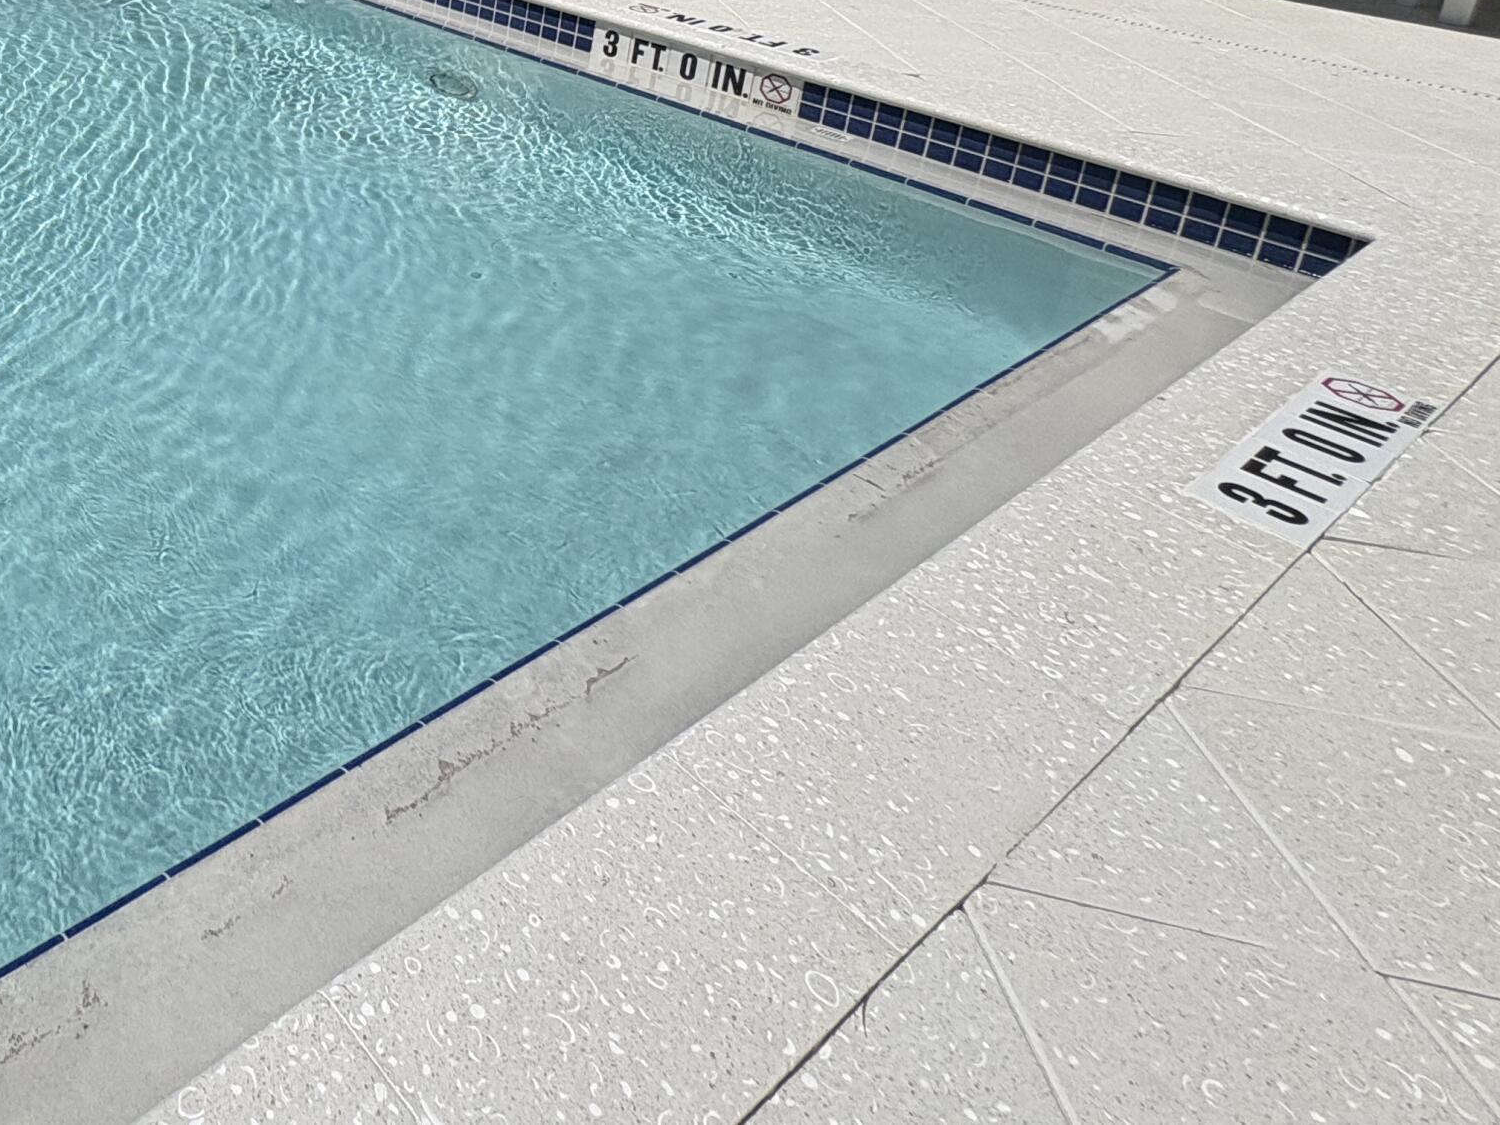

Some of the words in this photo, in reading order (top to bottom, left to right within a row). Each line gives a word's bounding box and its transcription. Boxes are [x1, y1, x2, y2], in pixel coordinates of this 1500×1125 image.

[603, 30, 620, 58] 3
[630, 38, 667, 73] FT.
[679, 52, 698, 81] 0
[711, 60, 749, 99] IN.
[753, 97, 764, 106] NO
[765, 102, 792, 115] DIVING
[1299, 400, 1401, 447] IN.
[1396, 415, 1422, 428] NO
[1404, 400, 1438, 422] DIVING
[1282, 428, 1366, 463] 0
[1239, 445, 1348, 504] FT.
[1218, 481, 1309, 525] 3
